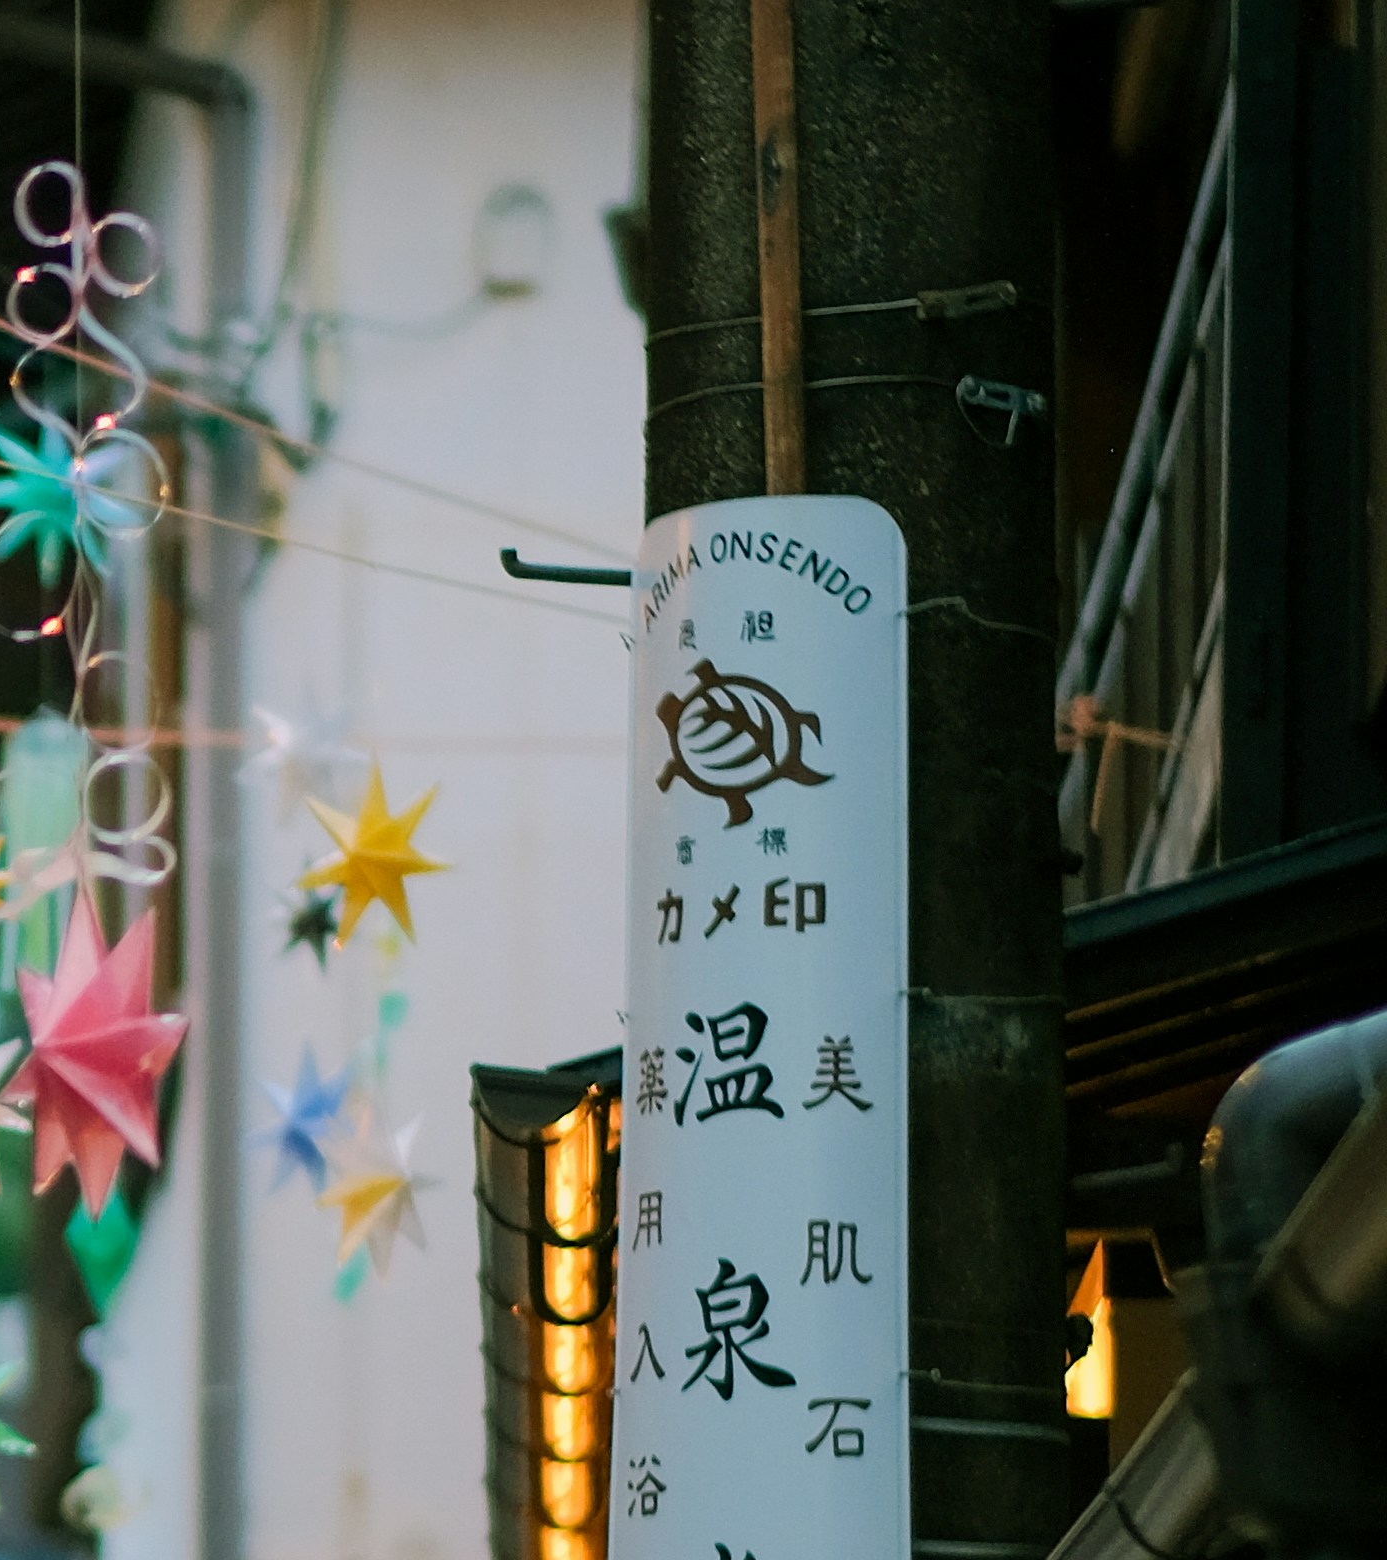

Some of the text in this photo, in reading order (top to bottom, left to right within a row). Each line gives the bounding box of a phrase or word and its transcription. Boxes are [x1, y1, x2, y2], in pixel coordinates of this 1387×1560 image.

[642, 530, 873, 634] ARIMA ONSENDO
[657, 876, 828, 946] カメ印
